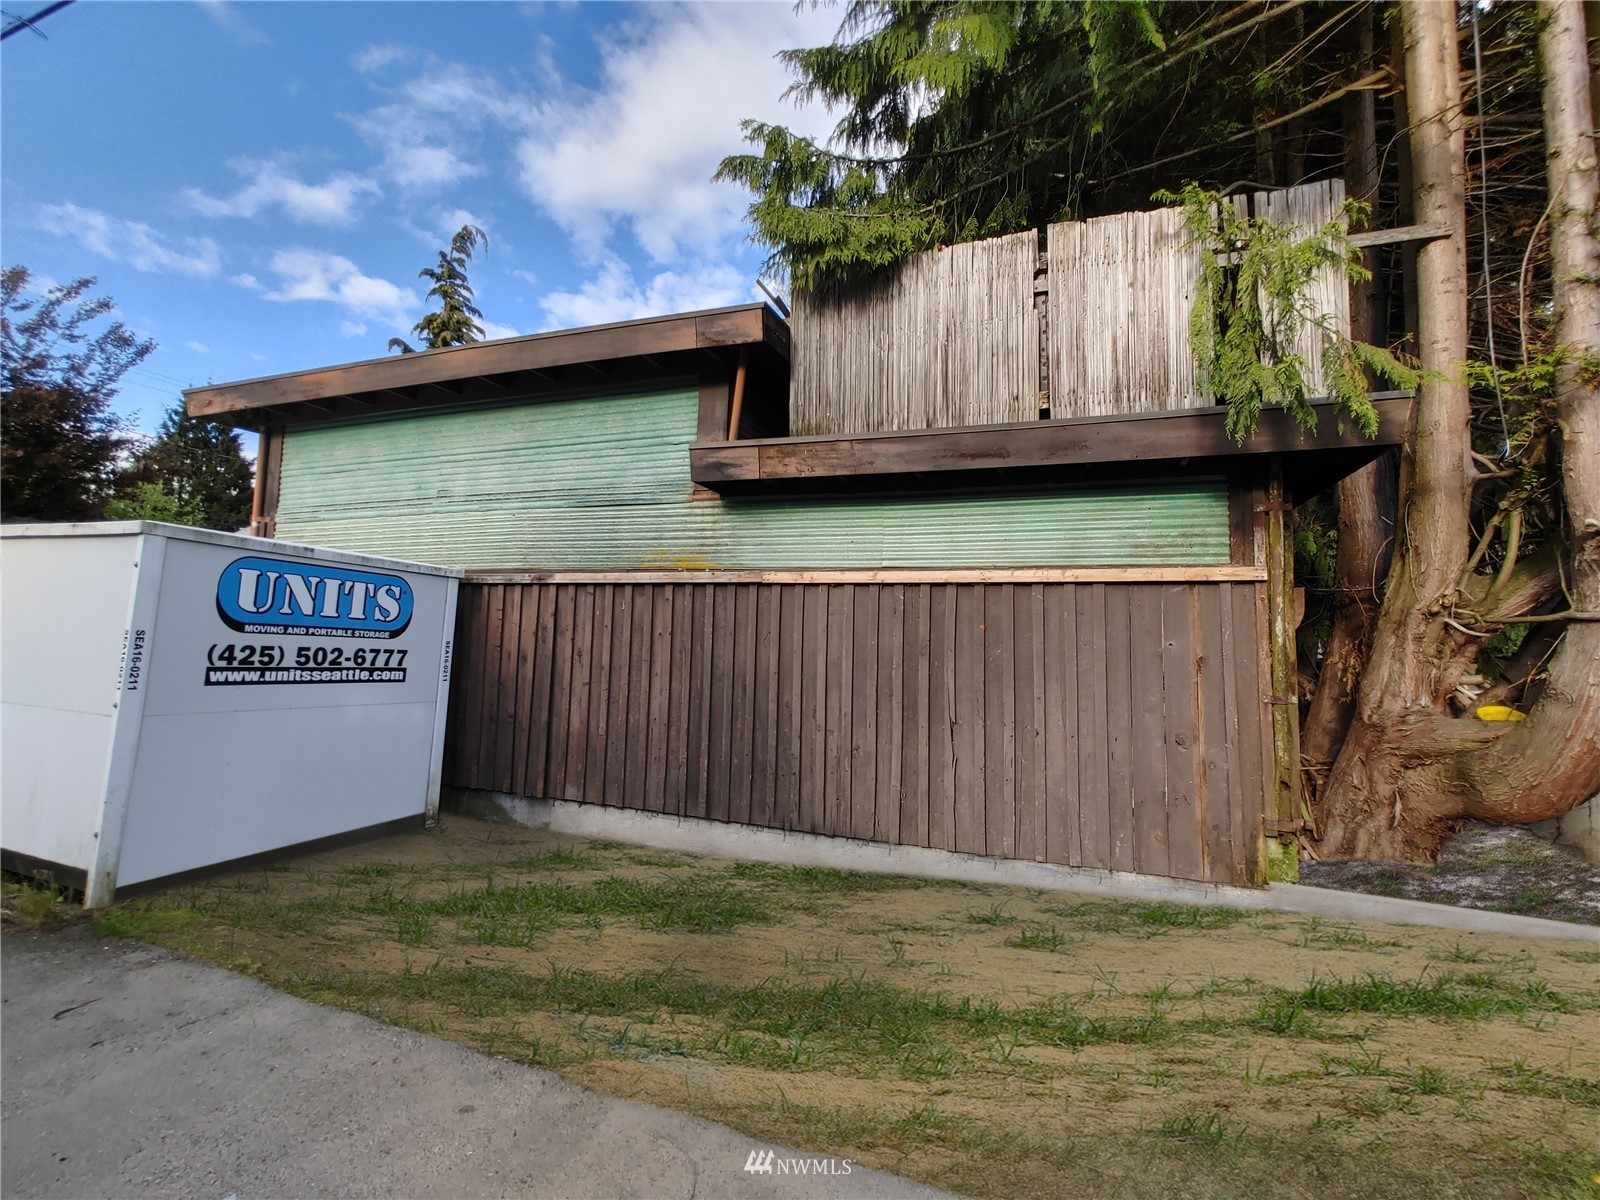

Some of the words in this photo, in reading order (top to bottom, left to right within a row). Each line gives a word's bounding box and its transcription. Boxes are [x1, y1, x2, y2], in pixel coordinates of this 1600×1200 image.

[237, 567, 401, 622] UNITS
[244, 624, 284, 634] MOVING
[286, 626, 306, 635] AND
[308, 628, 353, 637] PORTABLE
[354, 630, 390, 639] STORAGE
[127, 629, 146, 691] SEA16-0211
[207, 644, 285, 667] (425)
[295, 646, 408, 667] 502-6777
[209, 669, 404, 682] www.unitsseattle.com
